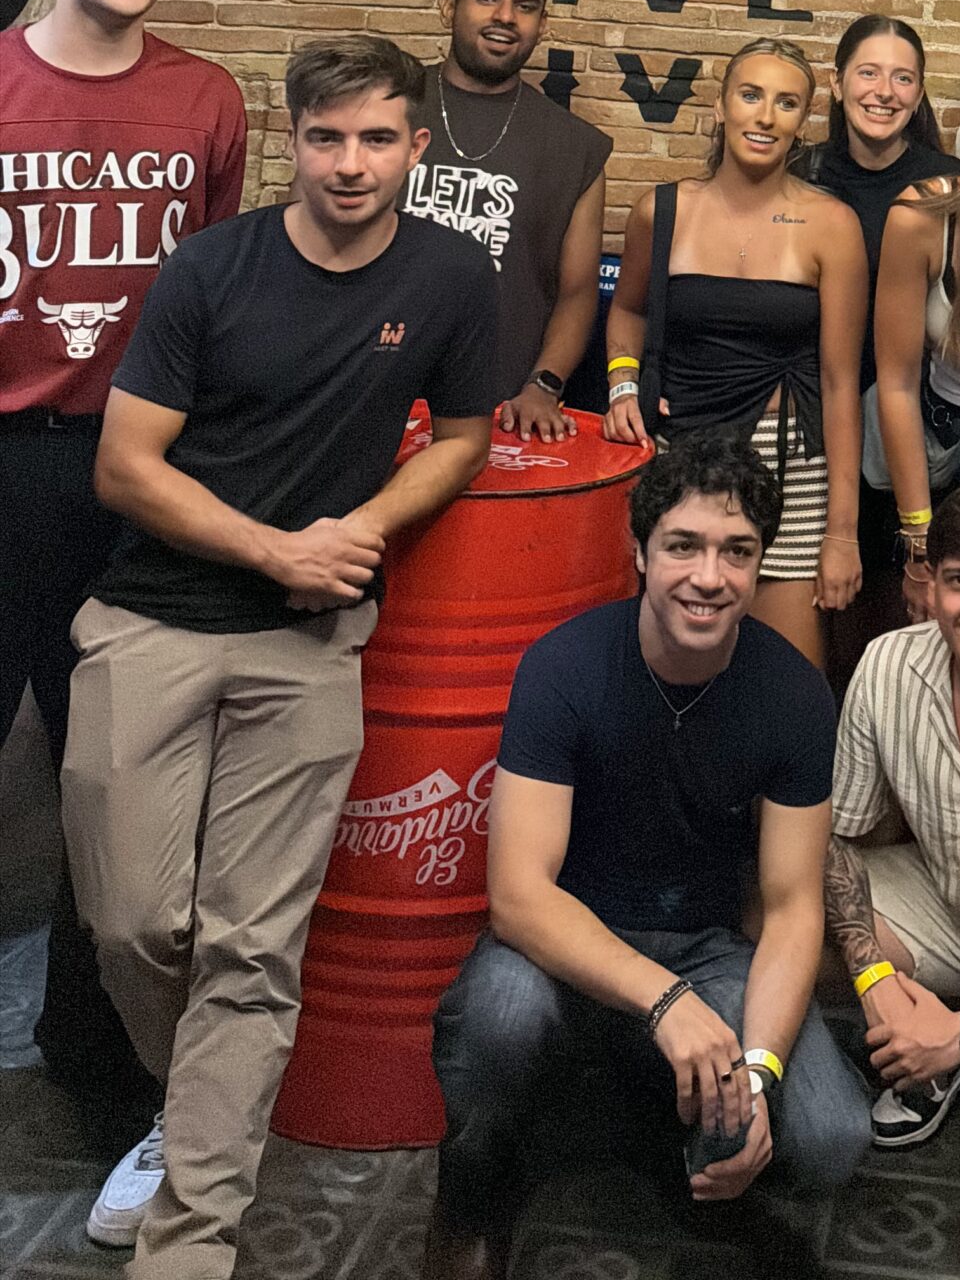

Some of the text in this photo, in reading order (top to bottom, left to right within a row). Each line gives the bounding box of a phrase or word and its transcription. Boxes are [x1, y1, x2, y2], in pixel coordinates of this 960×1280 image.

[0, 150, 196, 193] HICAGO
[403, 162, 520, 220] LET'S
[415, 836, 466, 886] El
